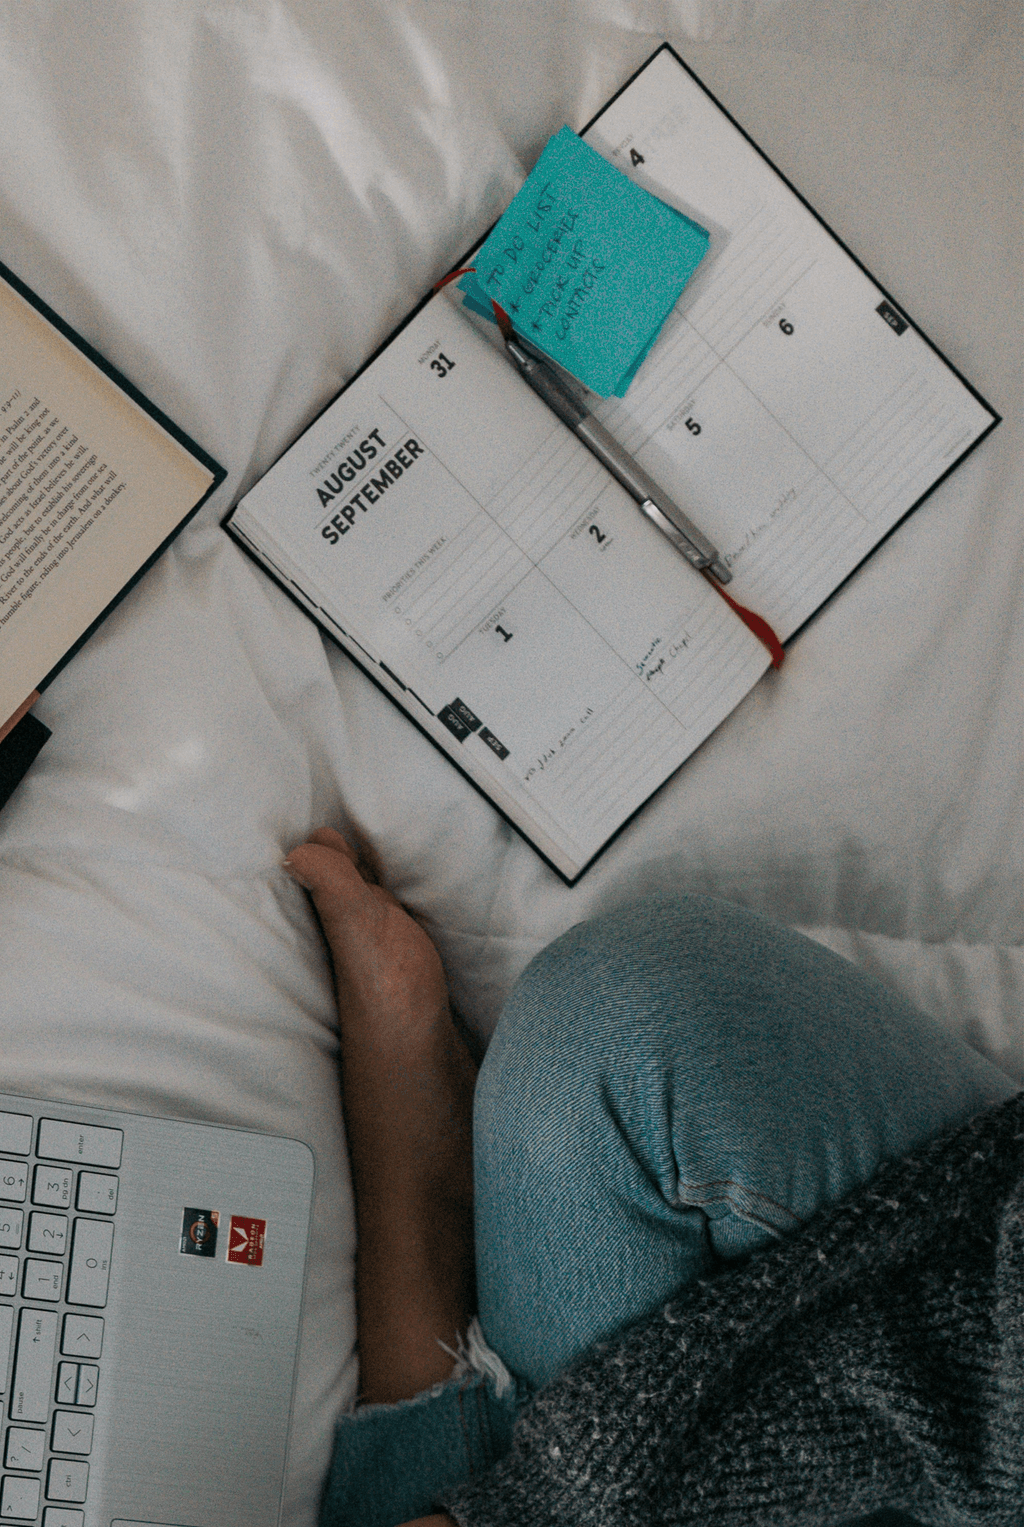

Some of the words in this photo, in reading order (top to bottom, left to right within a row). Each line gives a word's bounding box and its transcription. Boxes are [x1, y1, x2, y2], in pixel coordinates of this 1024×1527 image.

[626, 146, 646, 168] 4
[484, 262, 507, 287] TO
[502, 234, 527, 264] DO
[523, 180, 559, 232] LIST
[516, 207, 582, 296] GROCERIES
[536, 274, 572, 318] PICK
[563, 237, 588, 271] UP
[546, 257, 610, 342] CONTACTS
[776, 316, 795, 336] 6
[416, 339, 442, 365] MONDAY
[428, 351, 456, 379] 31
[683, 416, 703, 437] 5
[308, 449, 338, 478] TWENTY
[333, 424, 362, 452] TWENTY
[313, 427, 388, 508] AUGUST
[319, 437, 425, 546] SEPTEMBER
[568, 506, 602, 540] WEDNESDAY
[587, 523, 607, 544] 2
[18, 578, 42, 602] figure,
[38, 558, 60, 581] riding
[55, 545, 70, 561] into
[64, 517, 95, 550] Jerusalem
[92, 508, 102, 519] on
[102, 480, 127, 507] donkey.
[381, 566, 418, 603] PRIORITIES
[414, 552, 431, 569] THIS
[478, 606, 508, 636] TUESDAY
[493, 623, 514, 643] 1
[76, 1133, 85, 1155] enter
[194, 1214, 206, 1250] RYZEN
[34, 1318, 43, 1335] shift
[16, 1390, 24, 1414] pause
